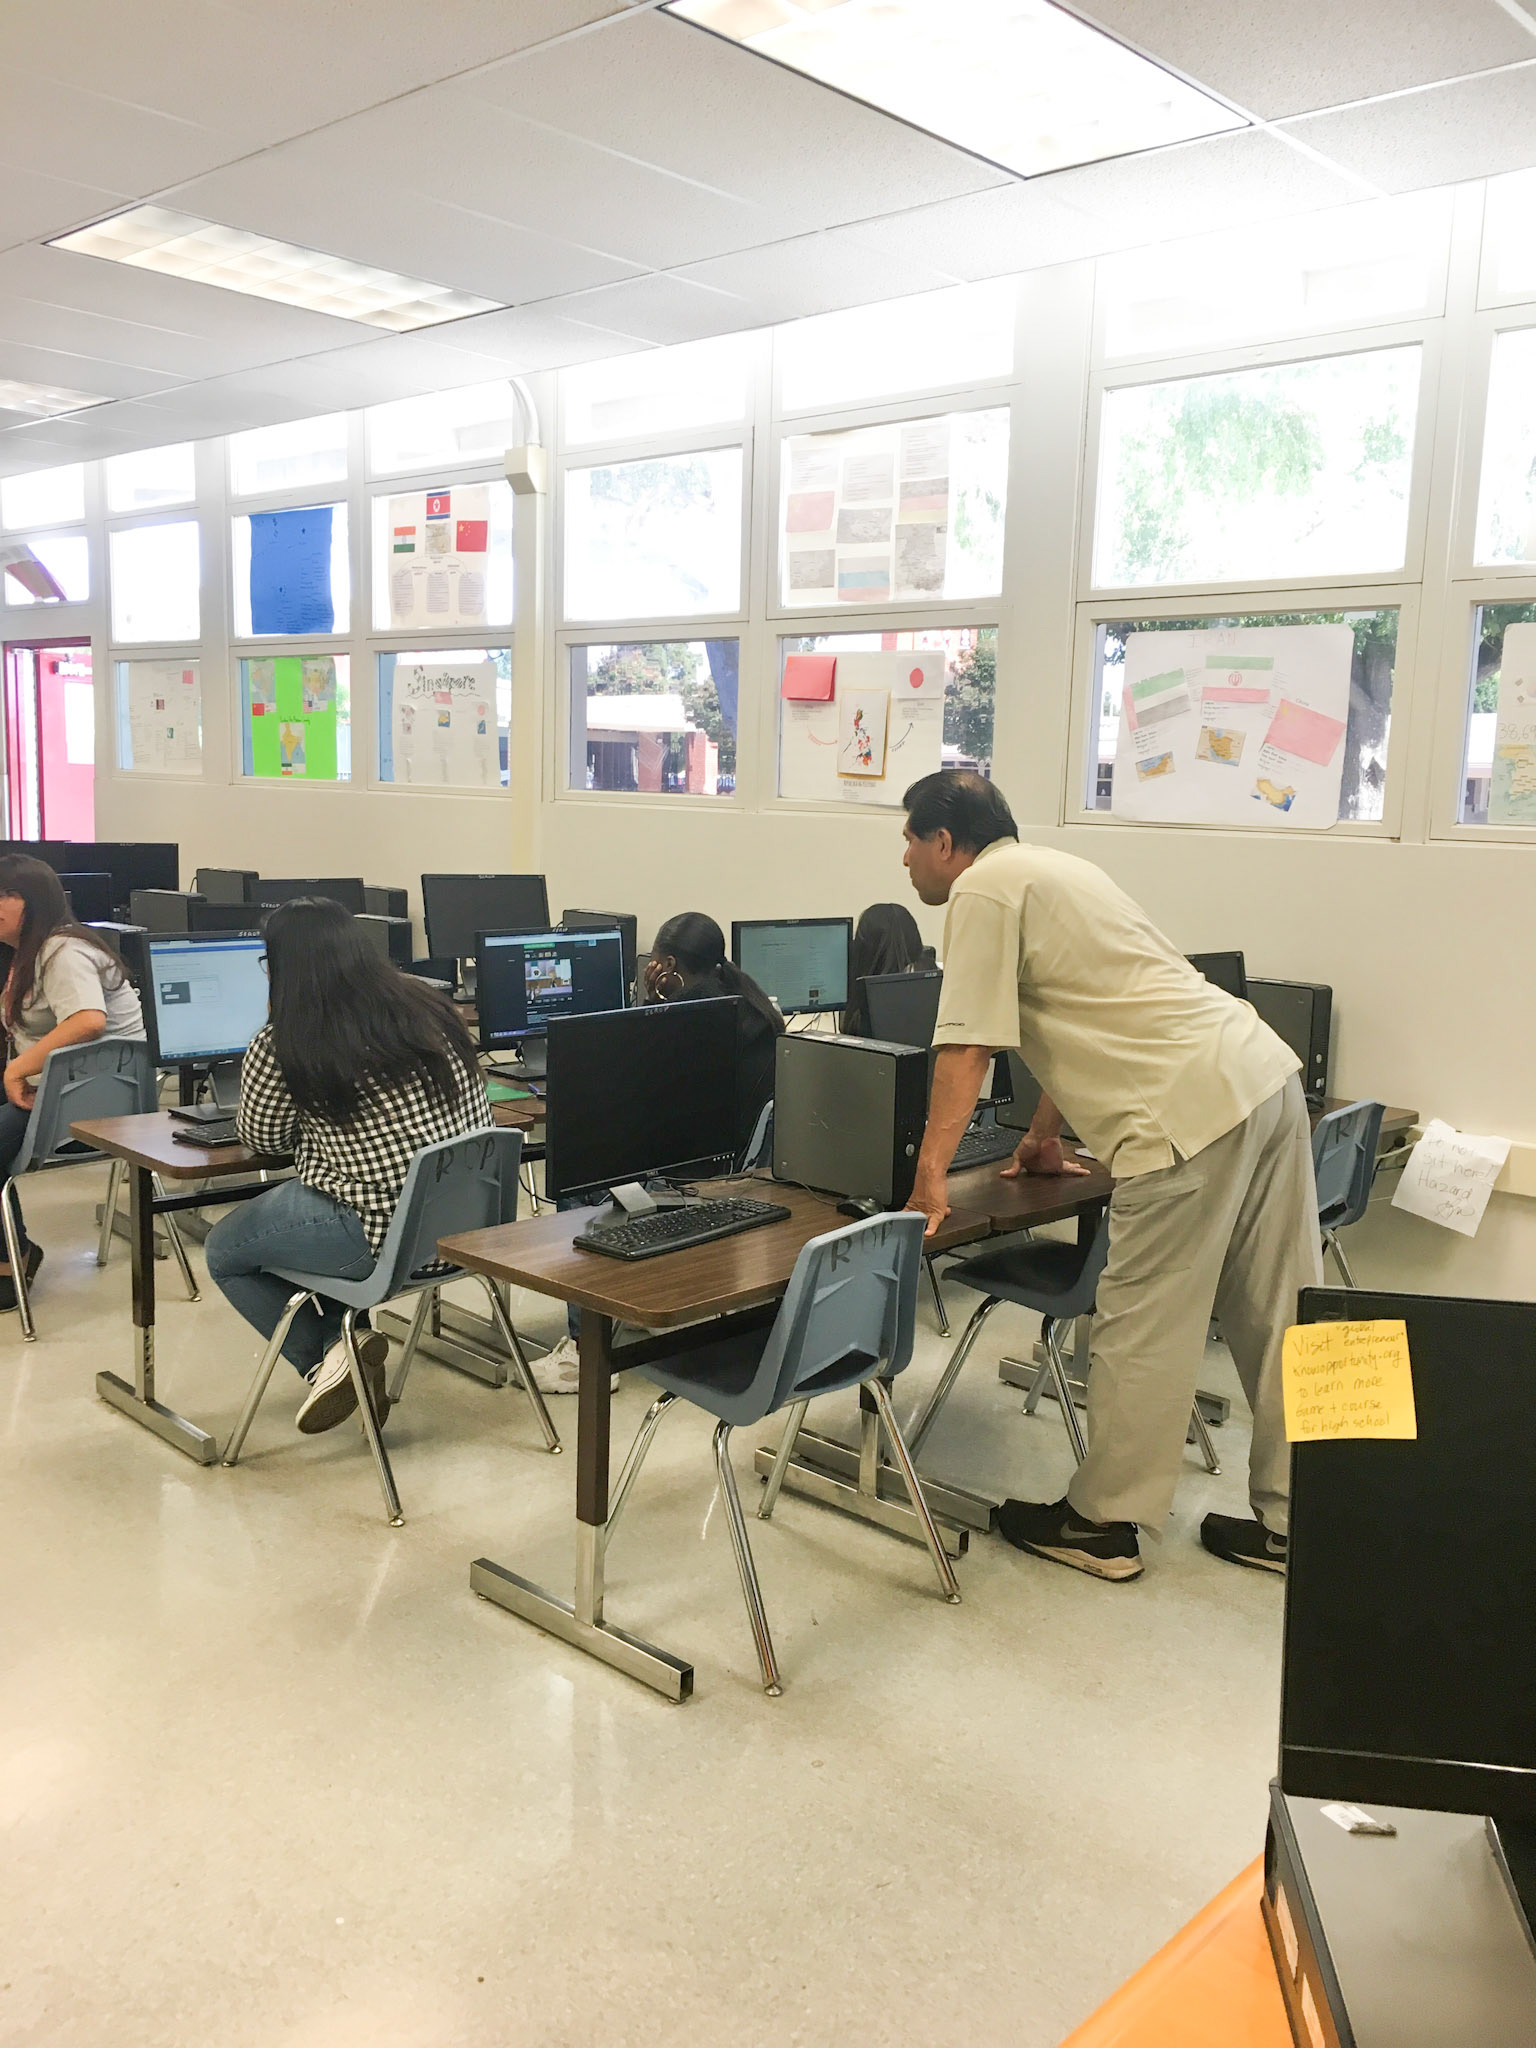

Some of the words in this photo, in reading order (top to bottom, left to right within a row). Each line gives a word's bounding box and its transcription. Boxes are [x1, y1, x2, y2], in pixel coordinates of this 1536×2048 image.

[436, 1136, 495, 1183] ROP
[1417, 1166, 1474, 1200] Hazard
[831, 1220, 894, 1273] ROP
[1293, 1330, 1335, 1356] Visit
[1314, 1380, 1344, 1397] learn
[1341, 1399, 1382, 1412] course
[1320, 1415, 1349, 1434] high
[1352, 1411, 1390, 1429] school
